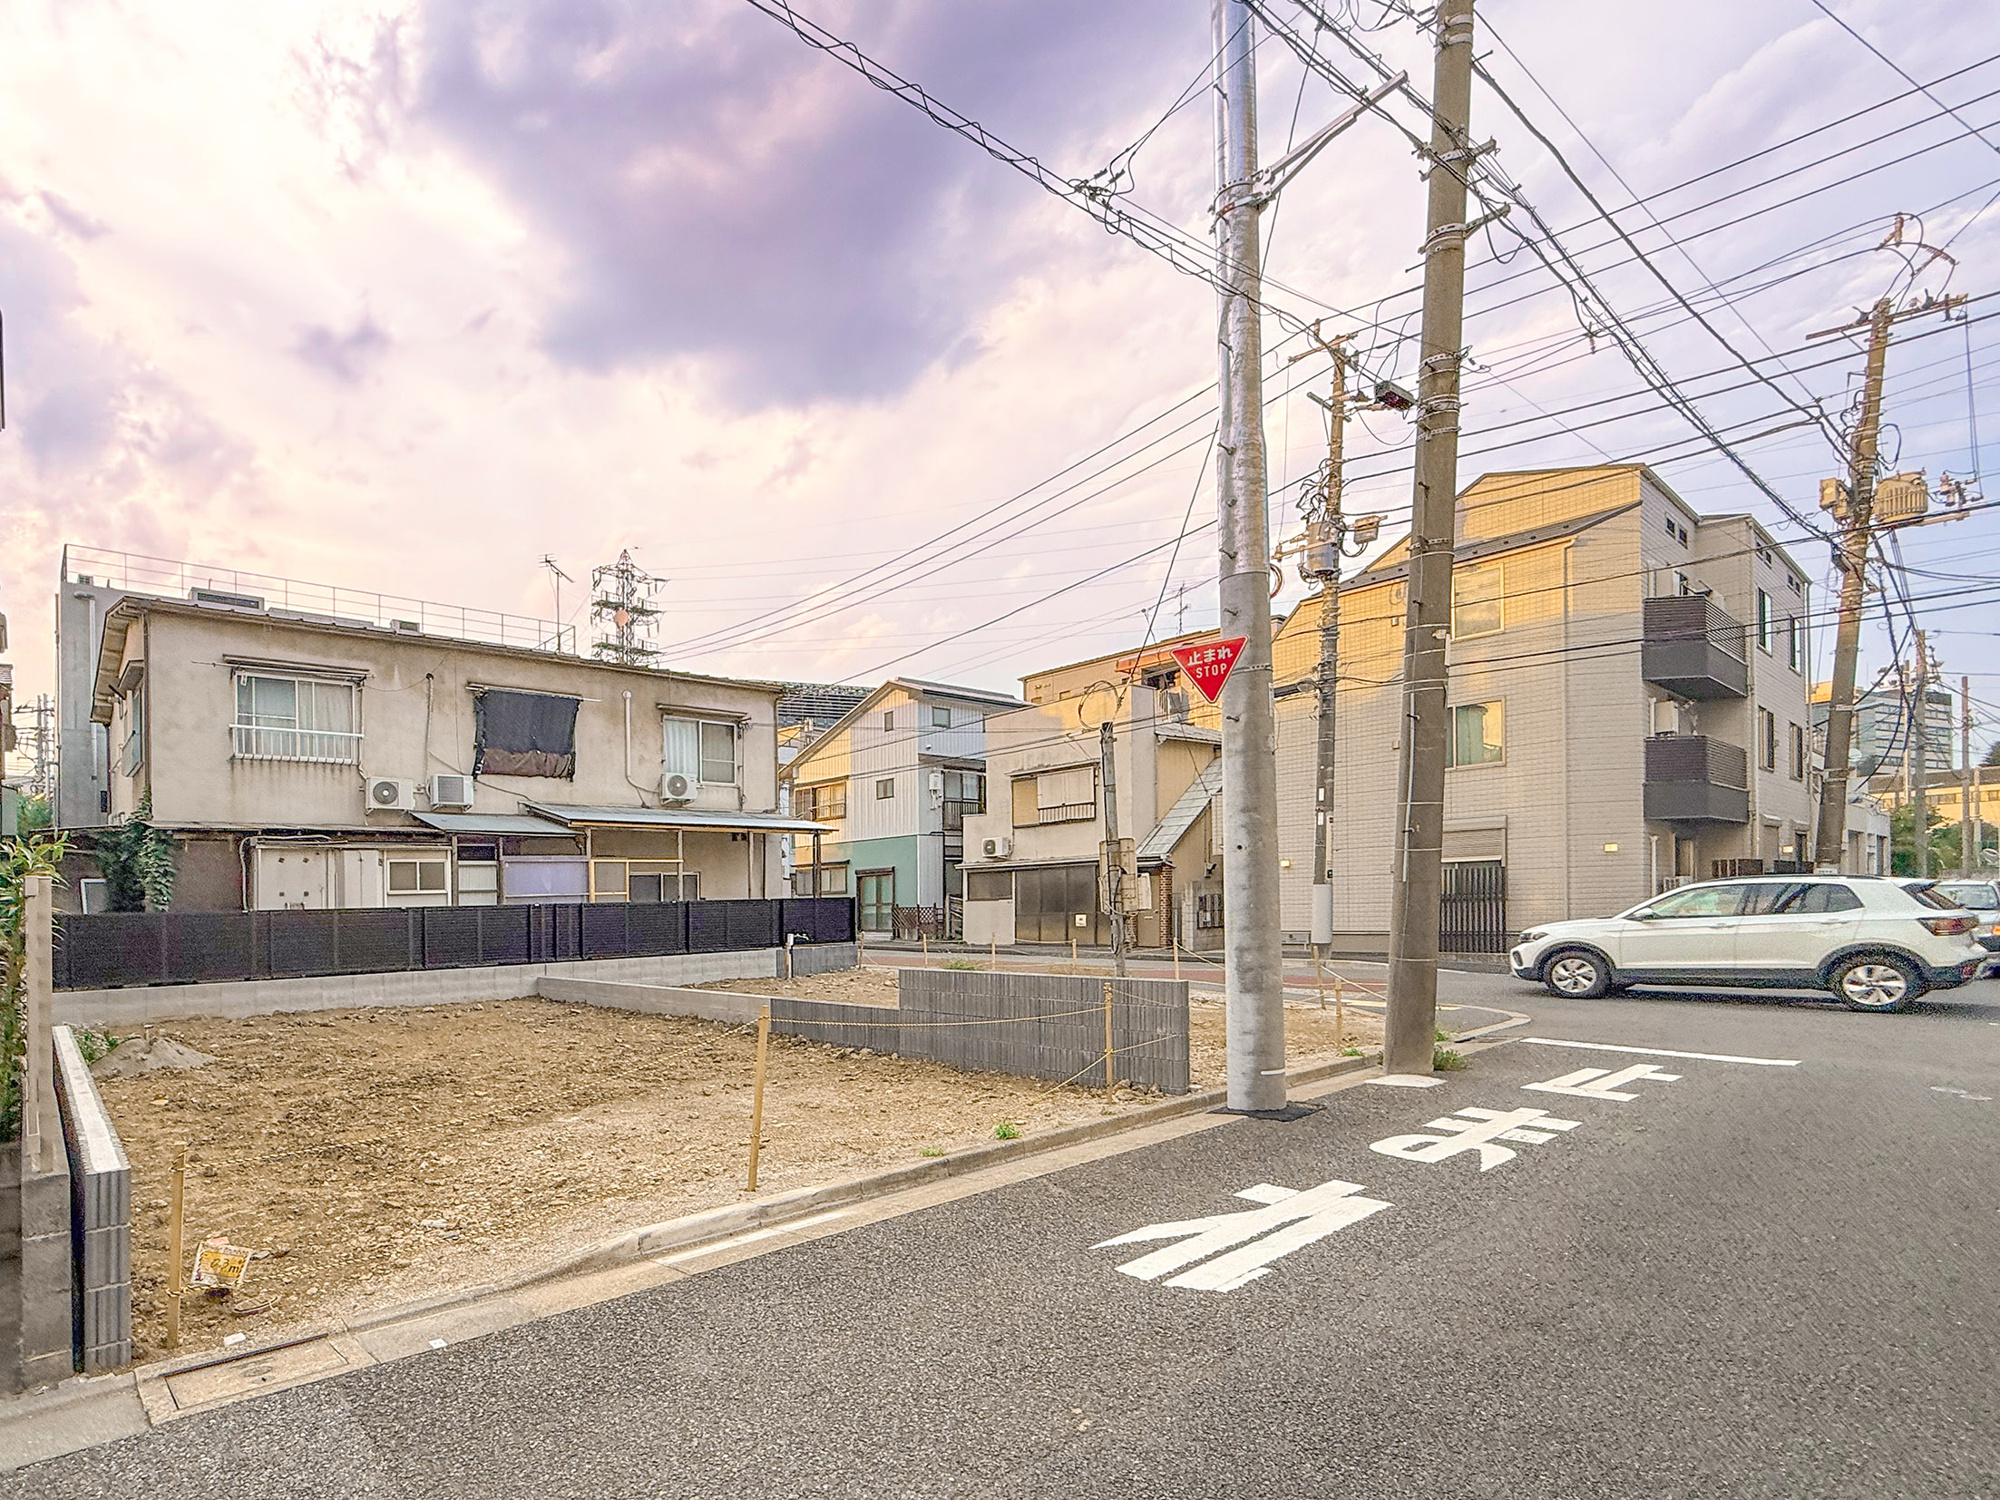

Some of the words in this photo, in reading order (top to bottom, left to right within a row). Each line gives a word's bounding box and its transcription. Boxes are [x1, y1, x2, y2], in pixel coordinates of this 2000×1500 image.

[1187, 645, 1233, 666] 止まれ
[1195, 662, 1227, 679] STOP
